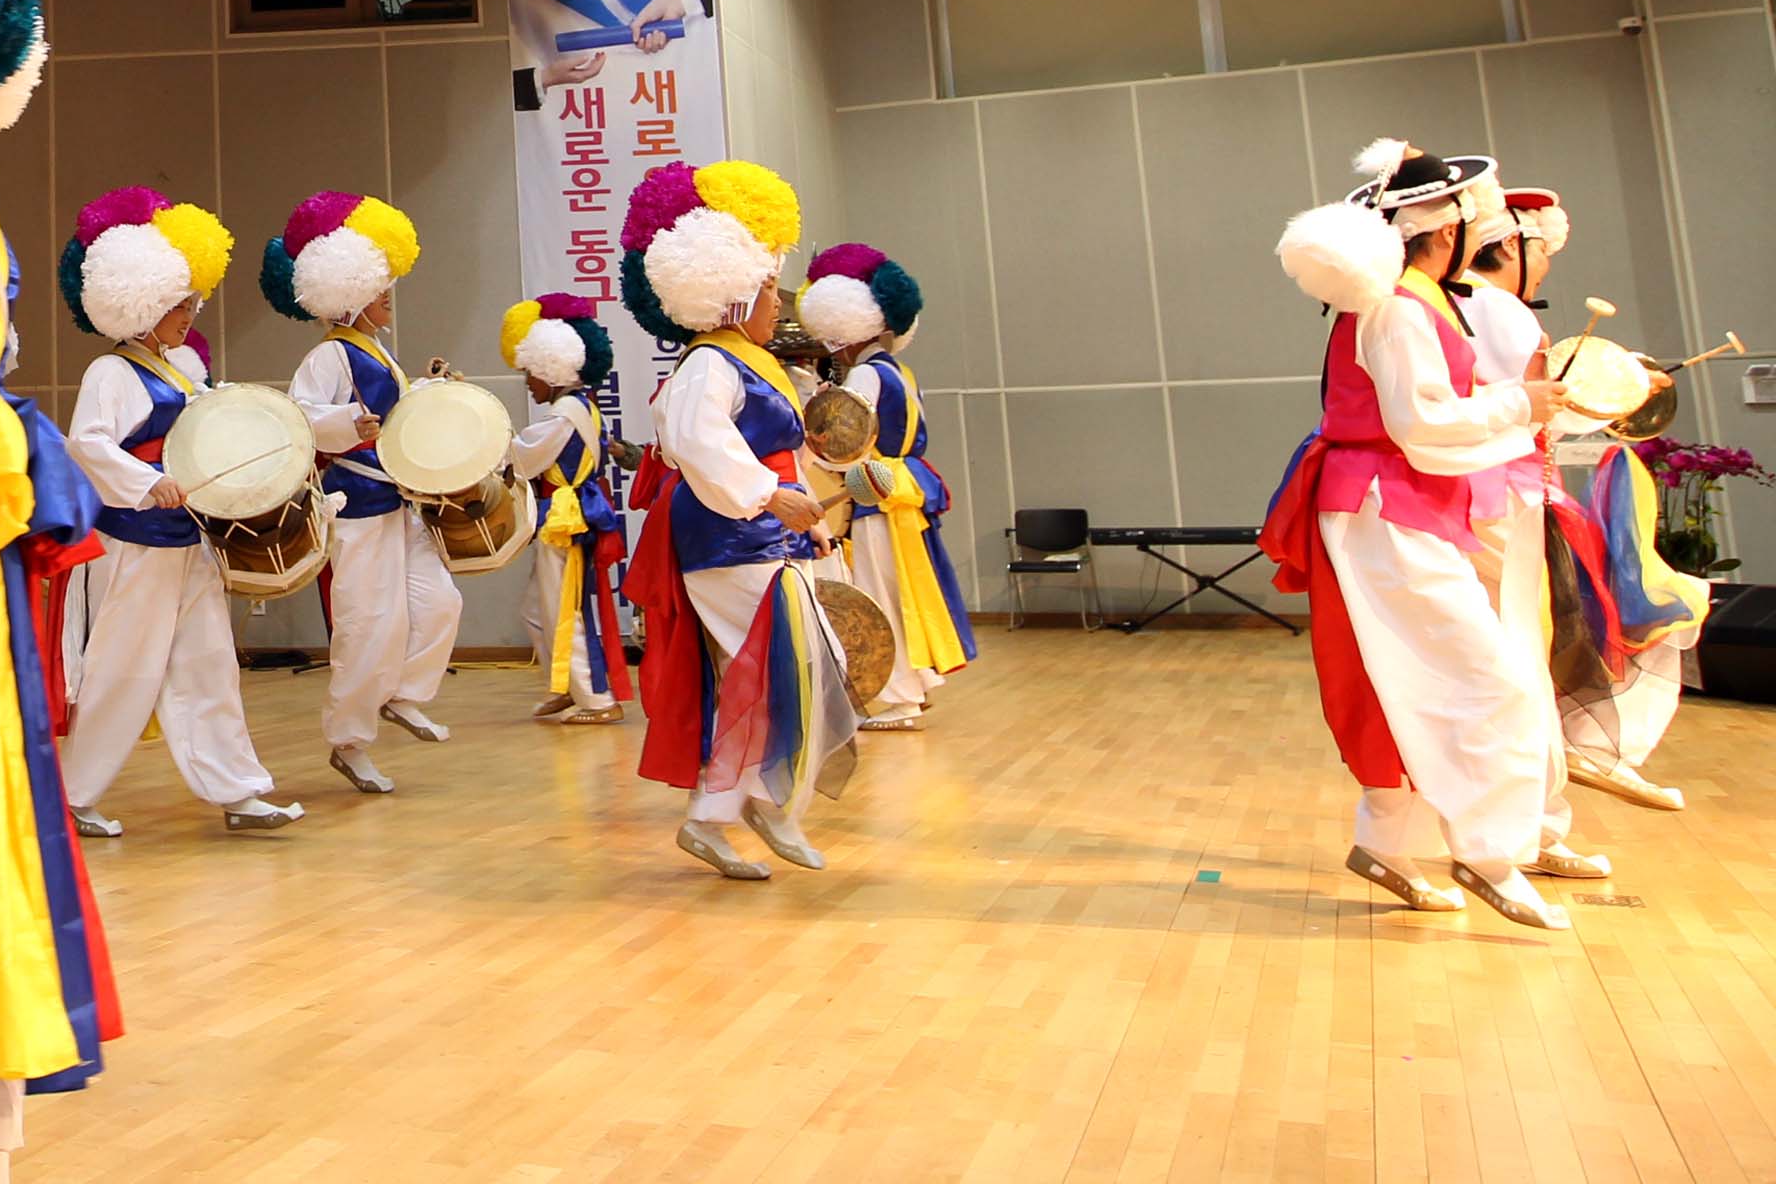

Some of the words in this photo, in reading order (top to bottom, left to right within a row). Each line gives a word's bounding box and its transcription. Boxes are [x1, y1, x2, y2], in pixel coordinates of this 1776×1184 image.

[559, 87, 612, 213] 새로운
[630, 69, 682, 182] 새로
[565, 229, 618, 319] 동구
